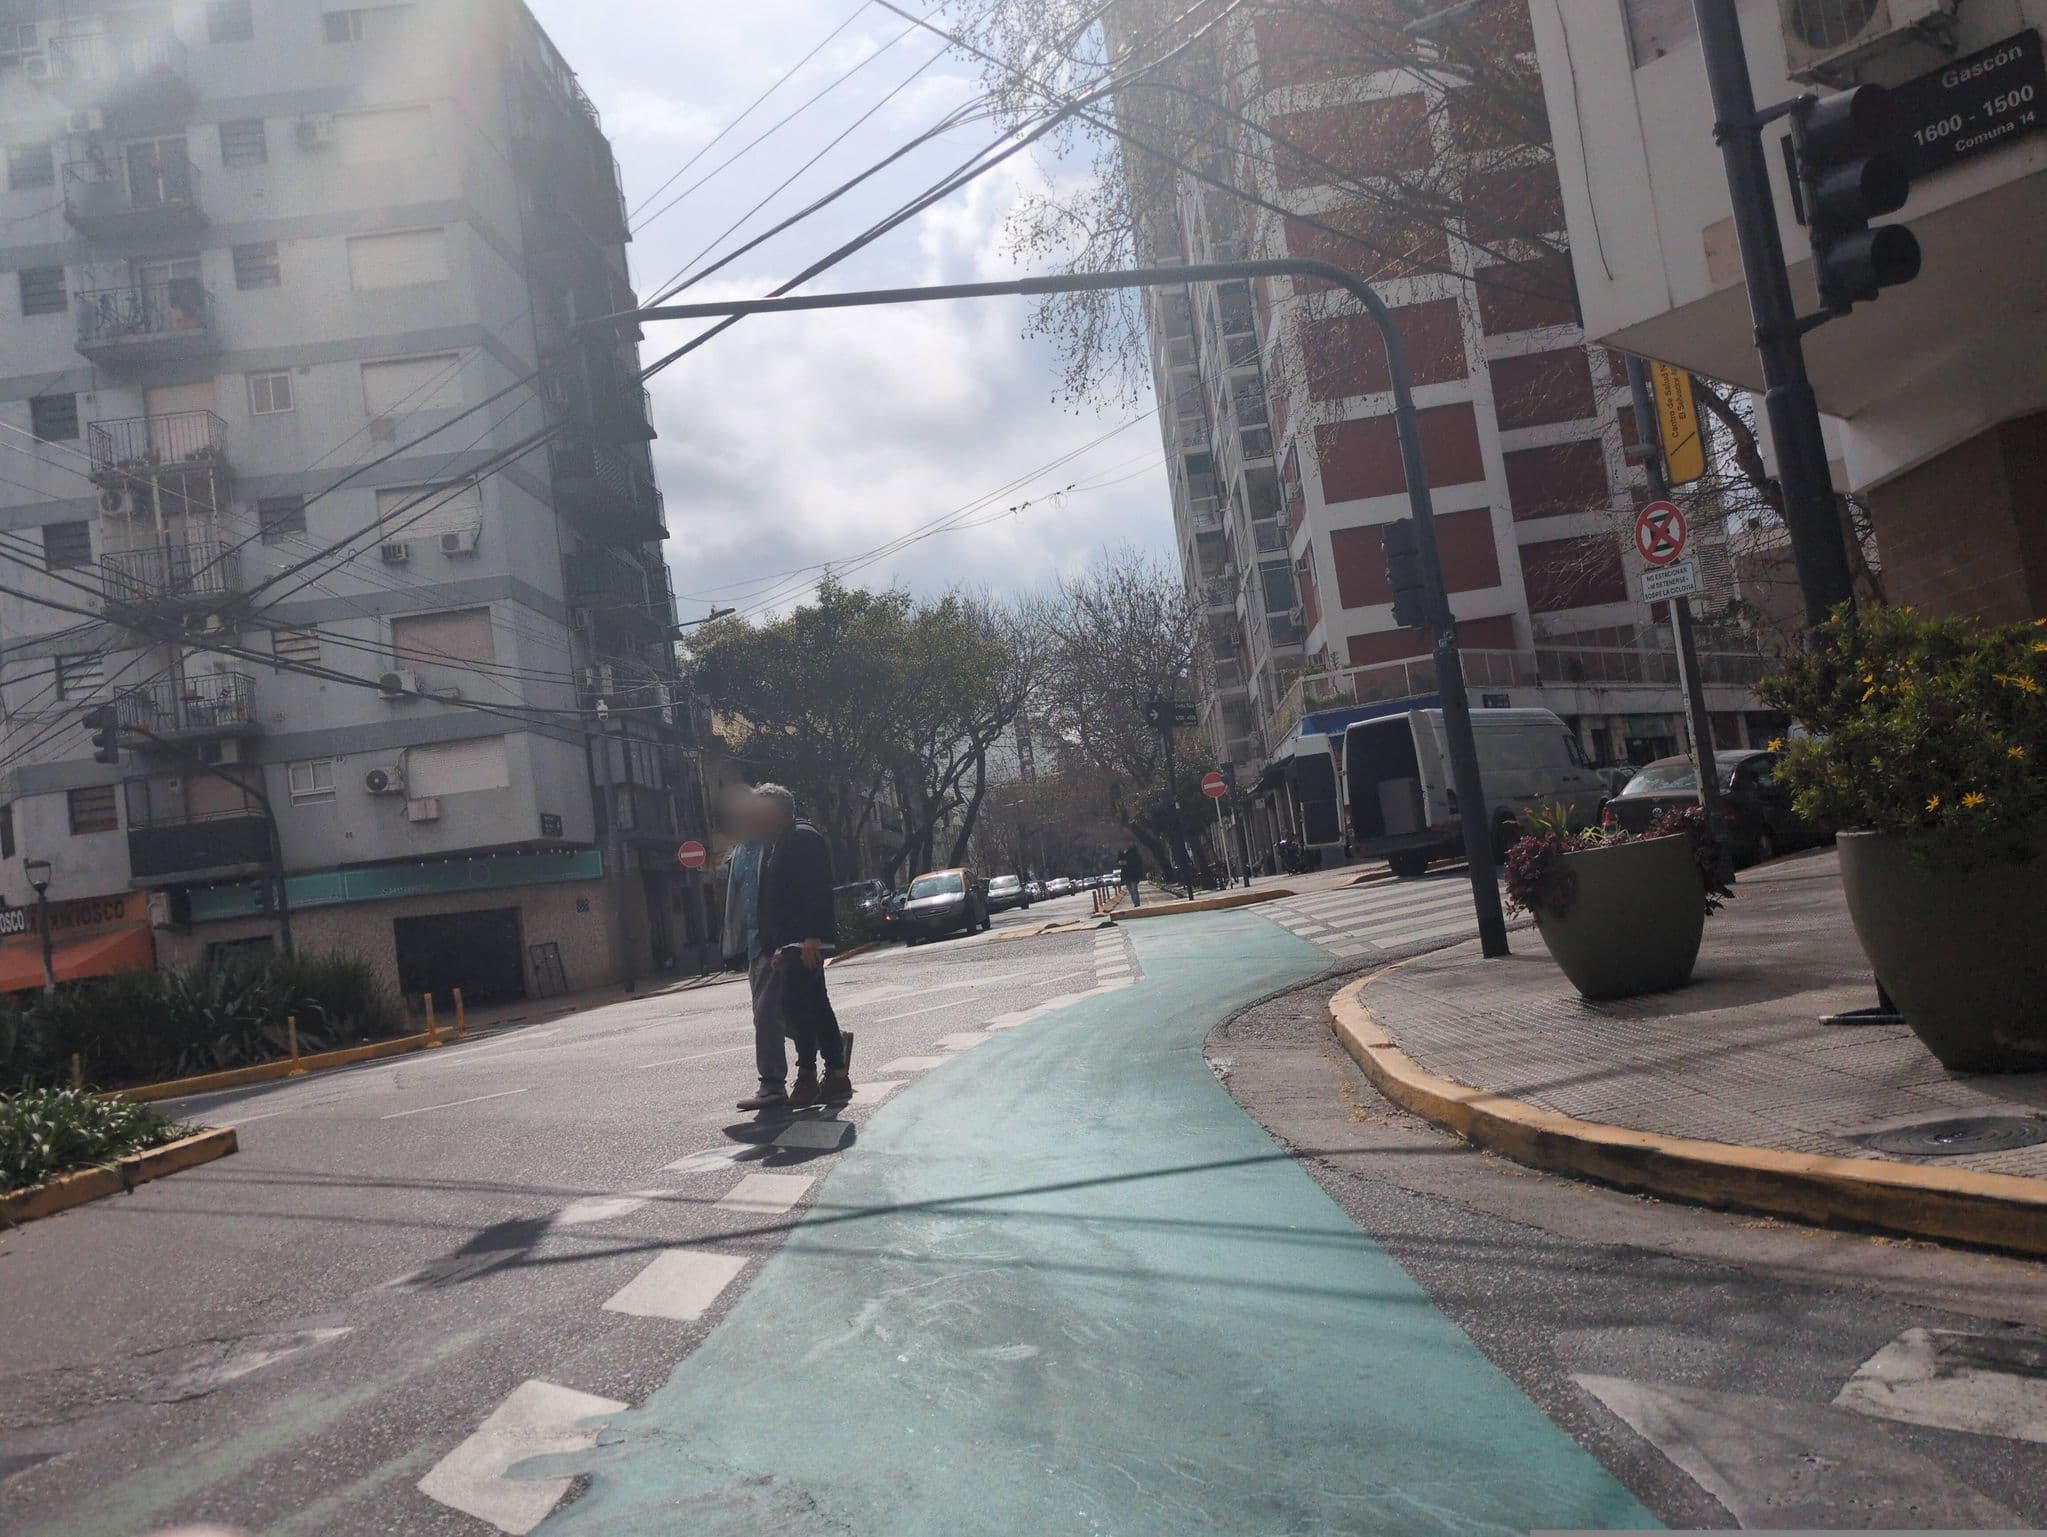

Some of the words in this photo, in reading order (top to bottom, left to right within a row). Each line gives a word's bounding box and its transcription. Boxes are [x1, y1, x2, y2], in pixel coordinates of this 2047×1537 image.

[1942, 45, 2023, 88] Gascón
[1913, 114, 1962, 146] 1600
[1982, 84, 2034, 117] 1500
[1955, 121, 2015, 152] Comuna
[2019, 111, 2035, 125] 14
[1661, 373, 1672, 396] Salud
[1666, 397, 1674, 409] de
[1670, 411, 1679, 438] Centro
[1655, 567, 1687, 580] ESTACIONAR
[1645, 590, 1662, 600] SOBRE
